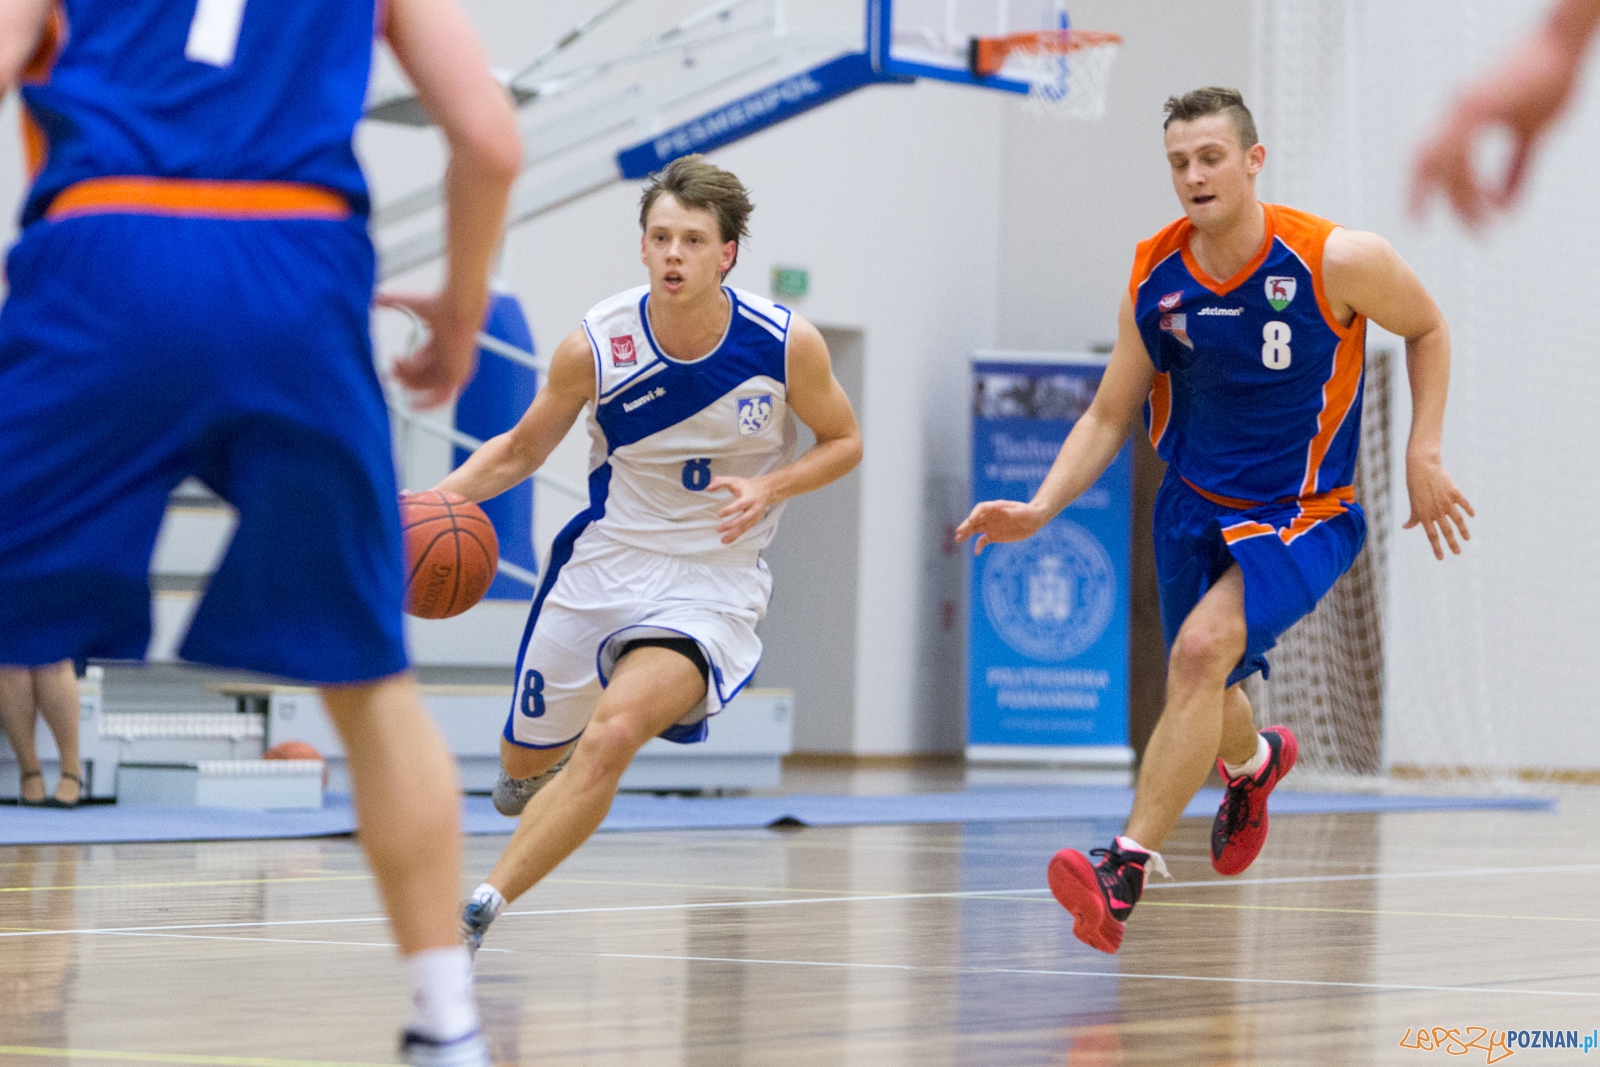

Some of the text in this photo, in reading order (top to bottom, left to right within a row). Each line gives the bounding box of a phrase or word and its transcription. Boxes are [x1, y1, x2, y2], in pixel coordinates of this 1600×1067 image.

[1261, 320, 1292, 370] 8
[682, 458, 712, 492] 8
[521, 668, 546, 718] 8
